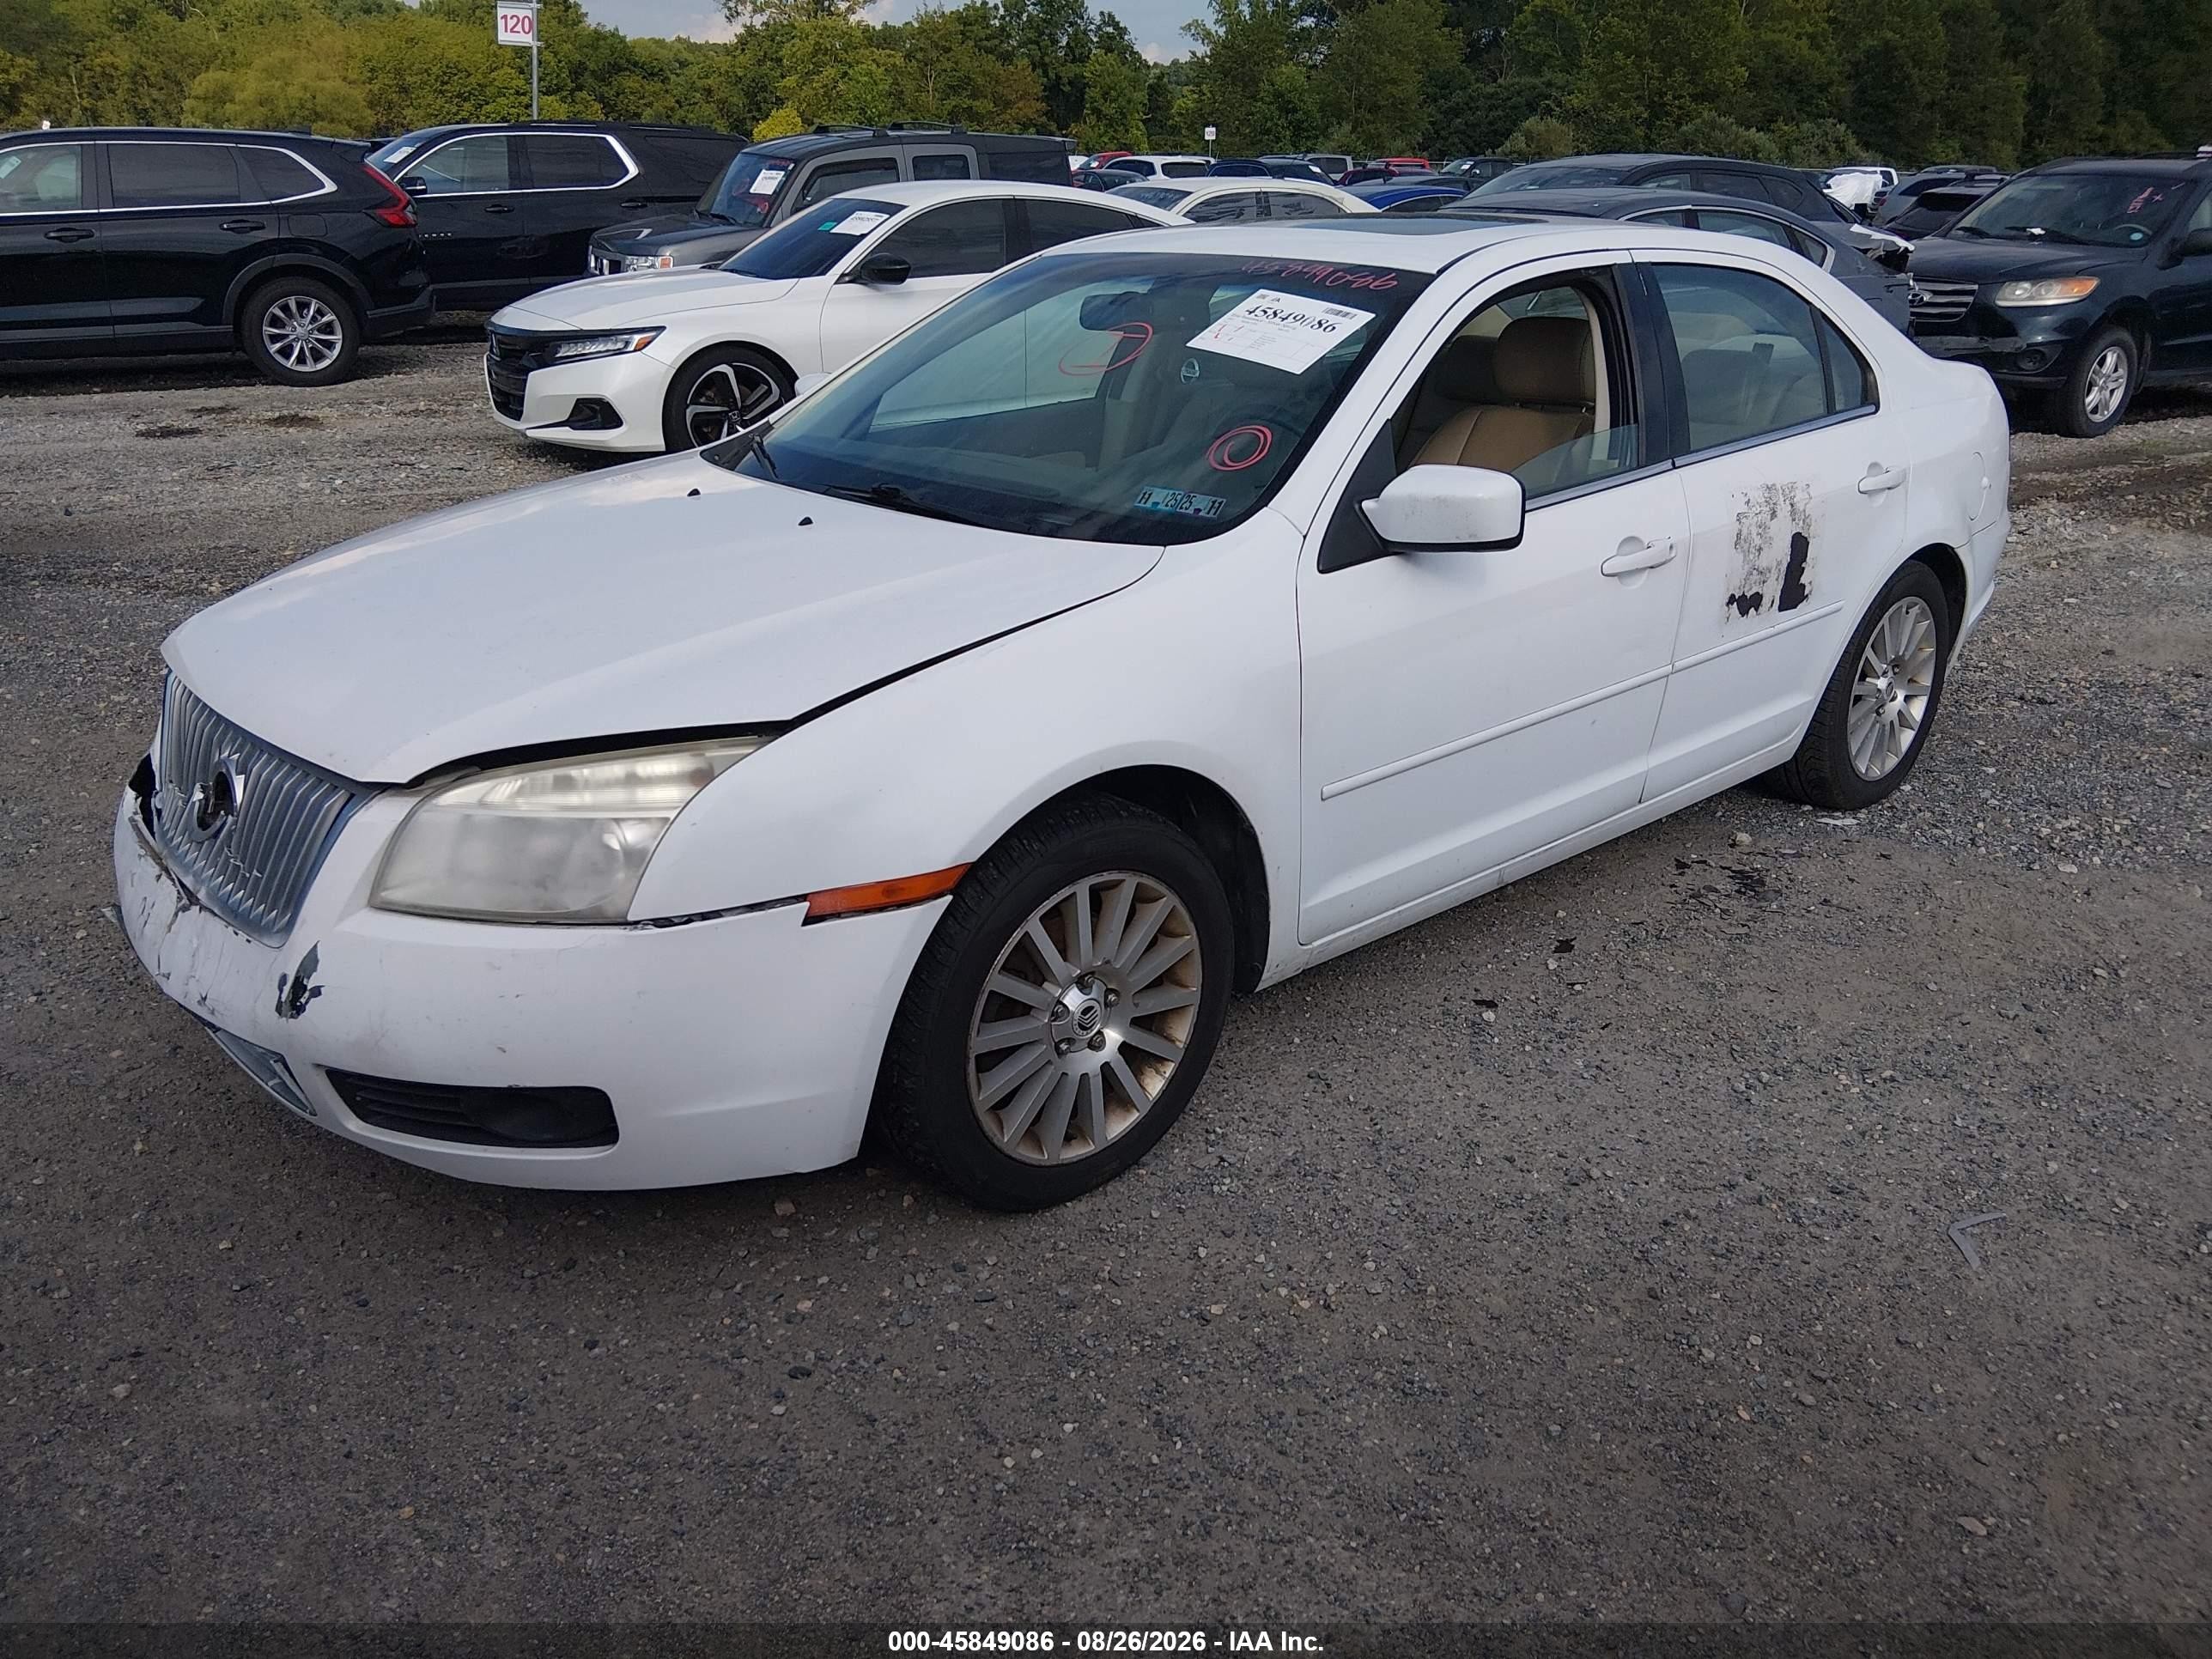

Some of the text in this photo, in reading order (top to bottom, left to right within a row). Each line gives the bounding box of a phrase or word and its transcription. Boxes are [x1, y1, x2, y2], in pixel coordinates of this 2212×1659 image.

[501, 14, 533, 34] 120
[1245, 305, 1341, 334] 45849086
[1165, 492, 1182, 508] 25
[1180, 494, 1196, 510] 25
